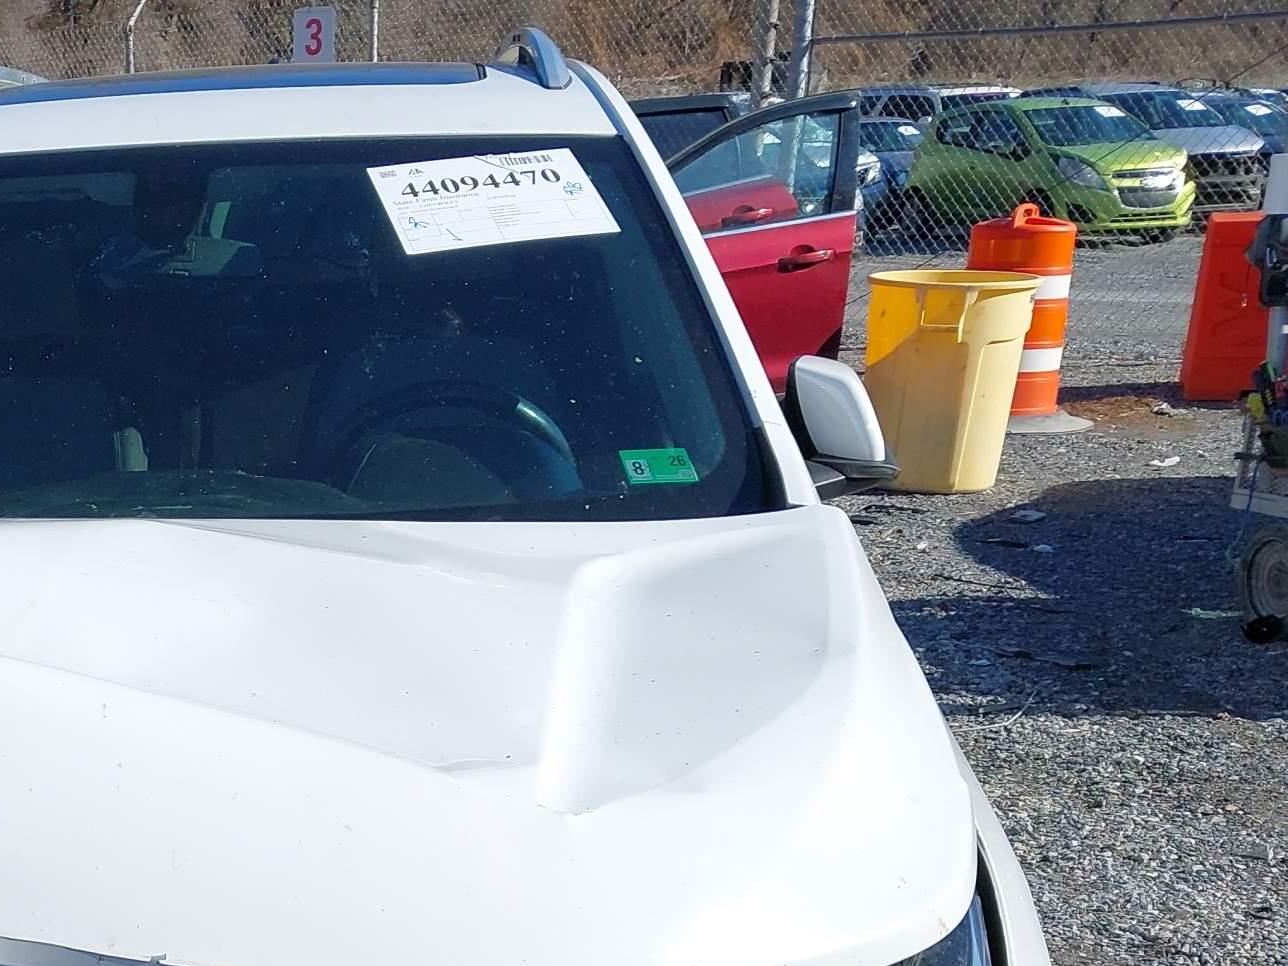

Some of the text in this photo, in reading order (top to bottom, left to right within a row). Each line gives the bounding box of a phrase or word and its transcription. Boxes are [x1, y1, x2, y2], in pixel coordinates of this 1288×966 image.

[304, 17, 323, 56] 3
[400, 167, 562, 198] 44094470
[439, 192, 480, 200] Insurance
[631, 460, 645, 476] 8
[668, 454, 686, 467] 26
